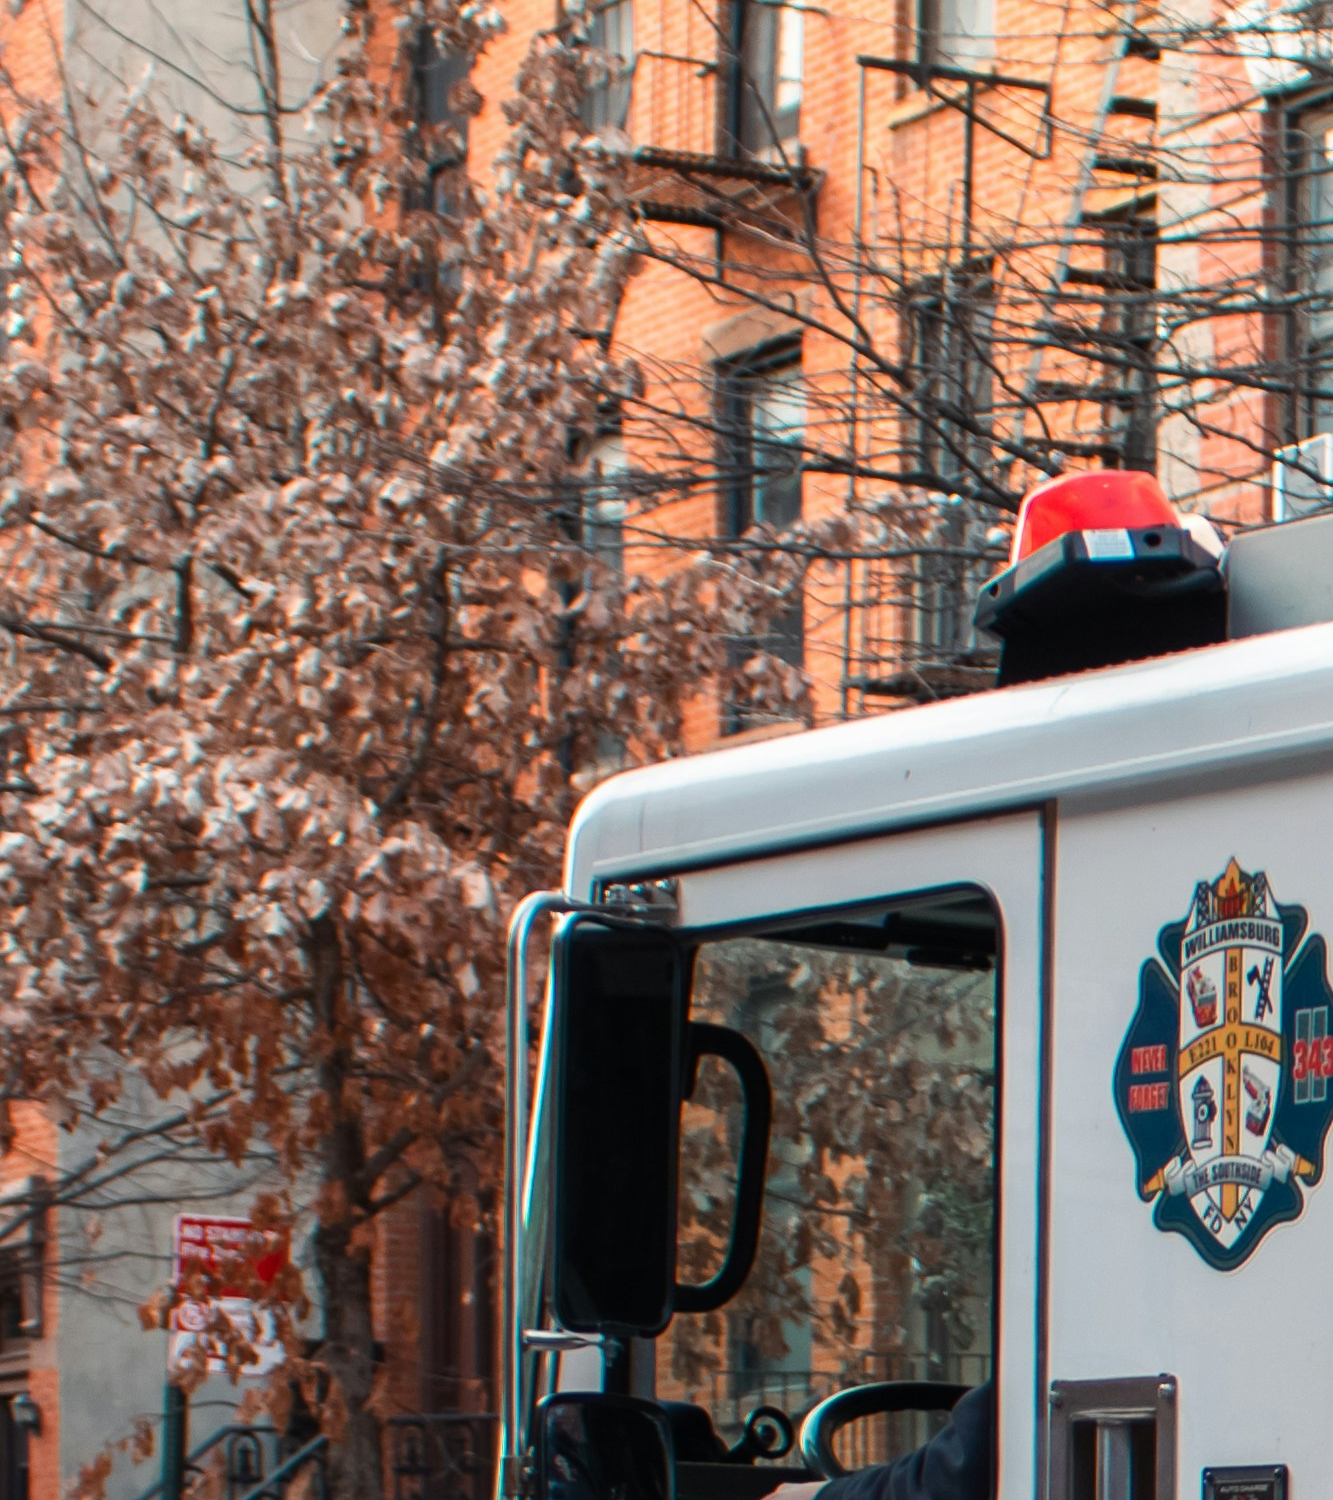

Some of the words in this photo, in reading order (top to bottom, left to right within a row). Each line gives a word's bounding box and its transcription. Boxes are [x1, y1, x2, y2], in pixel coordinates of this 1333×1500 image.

[1185, 921, 1281, 959] WILLIAMSBURG
[1132, 1045, 1168, 1075] NEVER
[1225, 955, 1239, 1151] BROOKLYN
[1128, 1082, 1169, 1114] FORGET
[1193, 1168, 1210, 1190] THE
[1211, 1162, 1262, 1185] SOUTHSIDE
